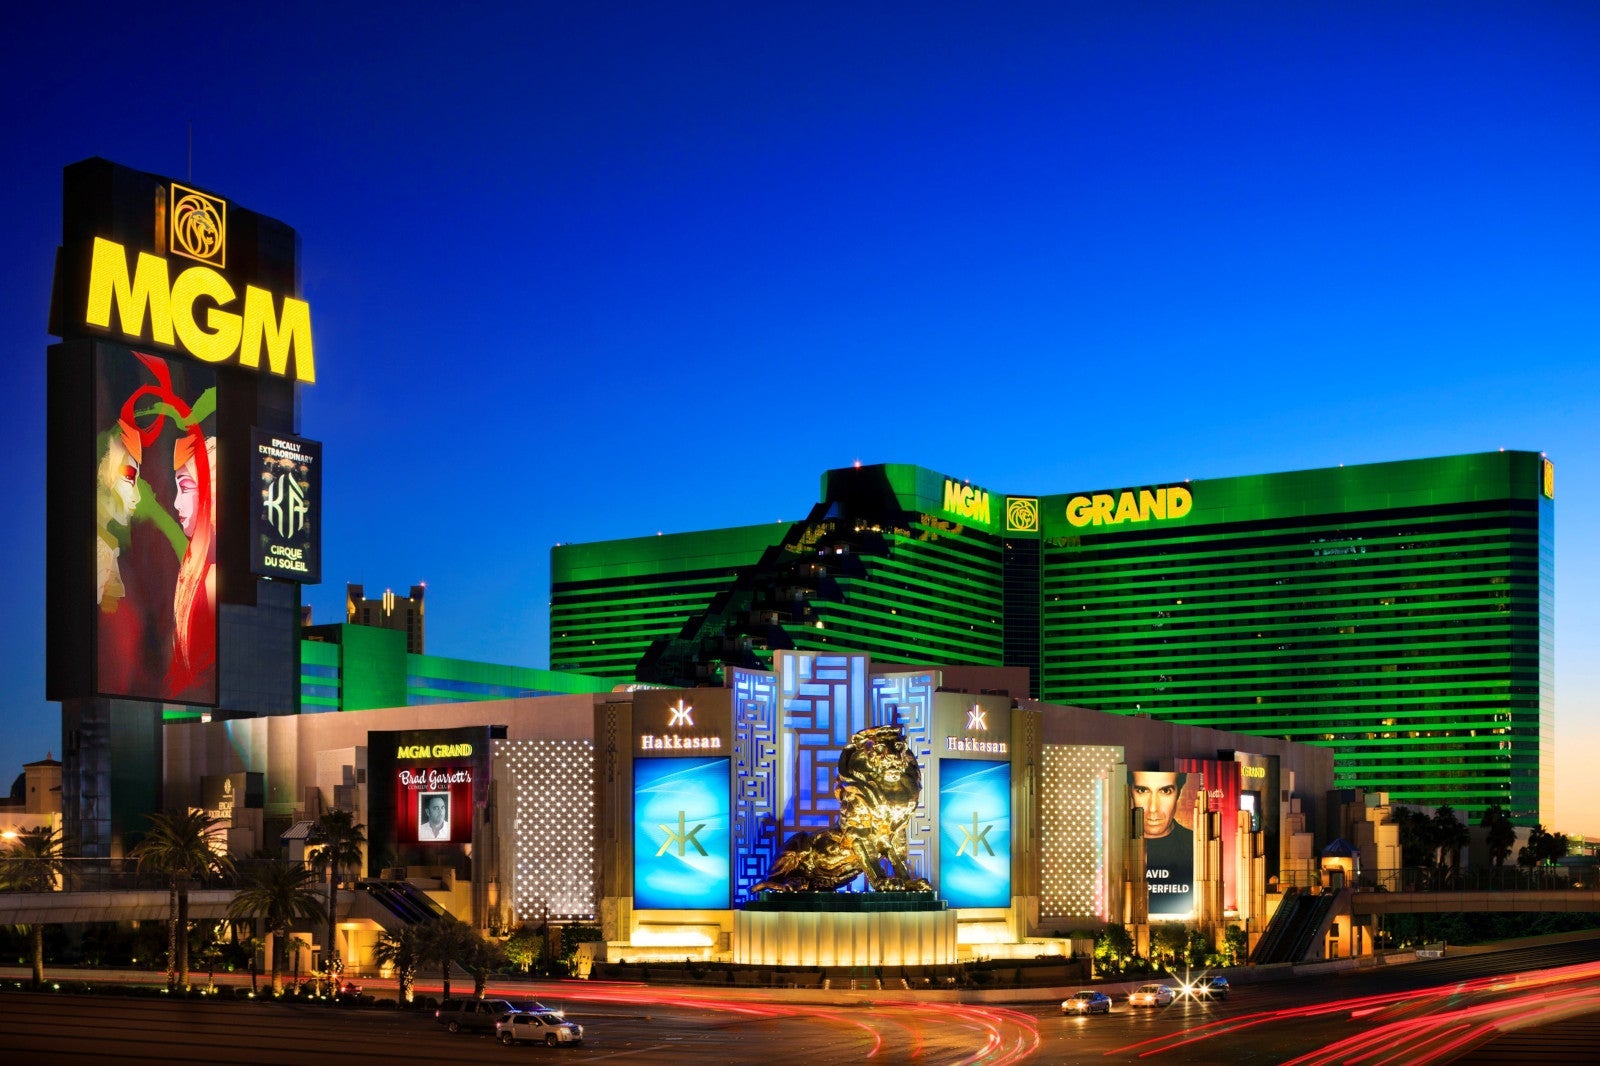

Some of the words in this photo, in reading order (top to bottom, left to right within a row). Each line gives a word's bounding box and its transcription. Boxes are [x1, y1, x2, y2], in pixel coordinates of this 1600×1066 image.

[85, 236, 316, 384] MGM
[271, 438, 301, 452] EPICALLY
[258, 444, 314, 464] EXTRAORDINARY
[943, 479, 991, 525] MGM
[1065, 486, 1193, 527] GRAND
[270, 544, 303, 561] CIRQUE
[264, 555, 278, 567] DU
[278, 558, 309, 572] SOLEIL
[641, 734, 722, 750] Hakkasan
[946, 736, 1008, 753] Hakkasan
[397, 745, 432, 759] MGM
[432, 743, 473, 758] GRAND
[398, 770, 427, 785] Brad
[428, 769, 473, 790] Garrett's
[1145, 869, 1170, 879] AVID
[1147, 884, 1190, 894] PERFIELD
